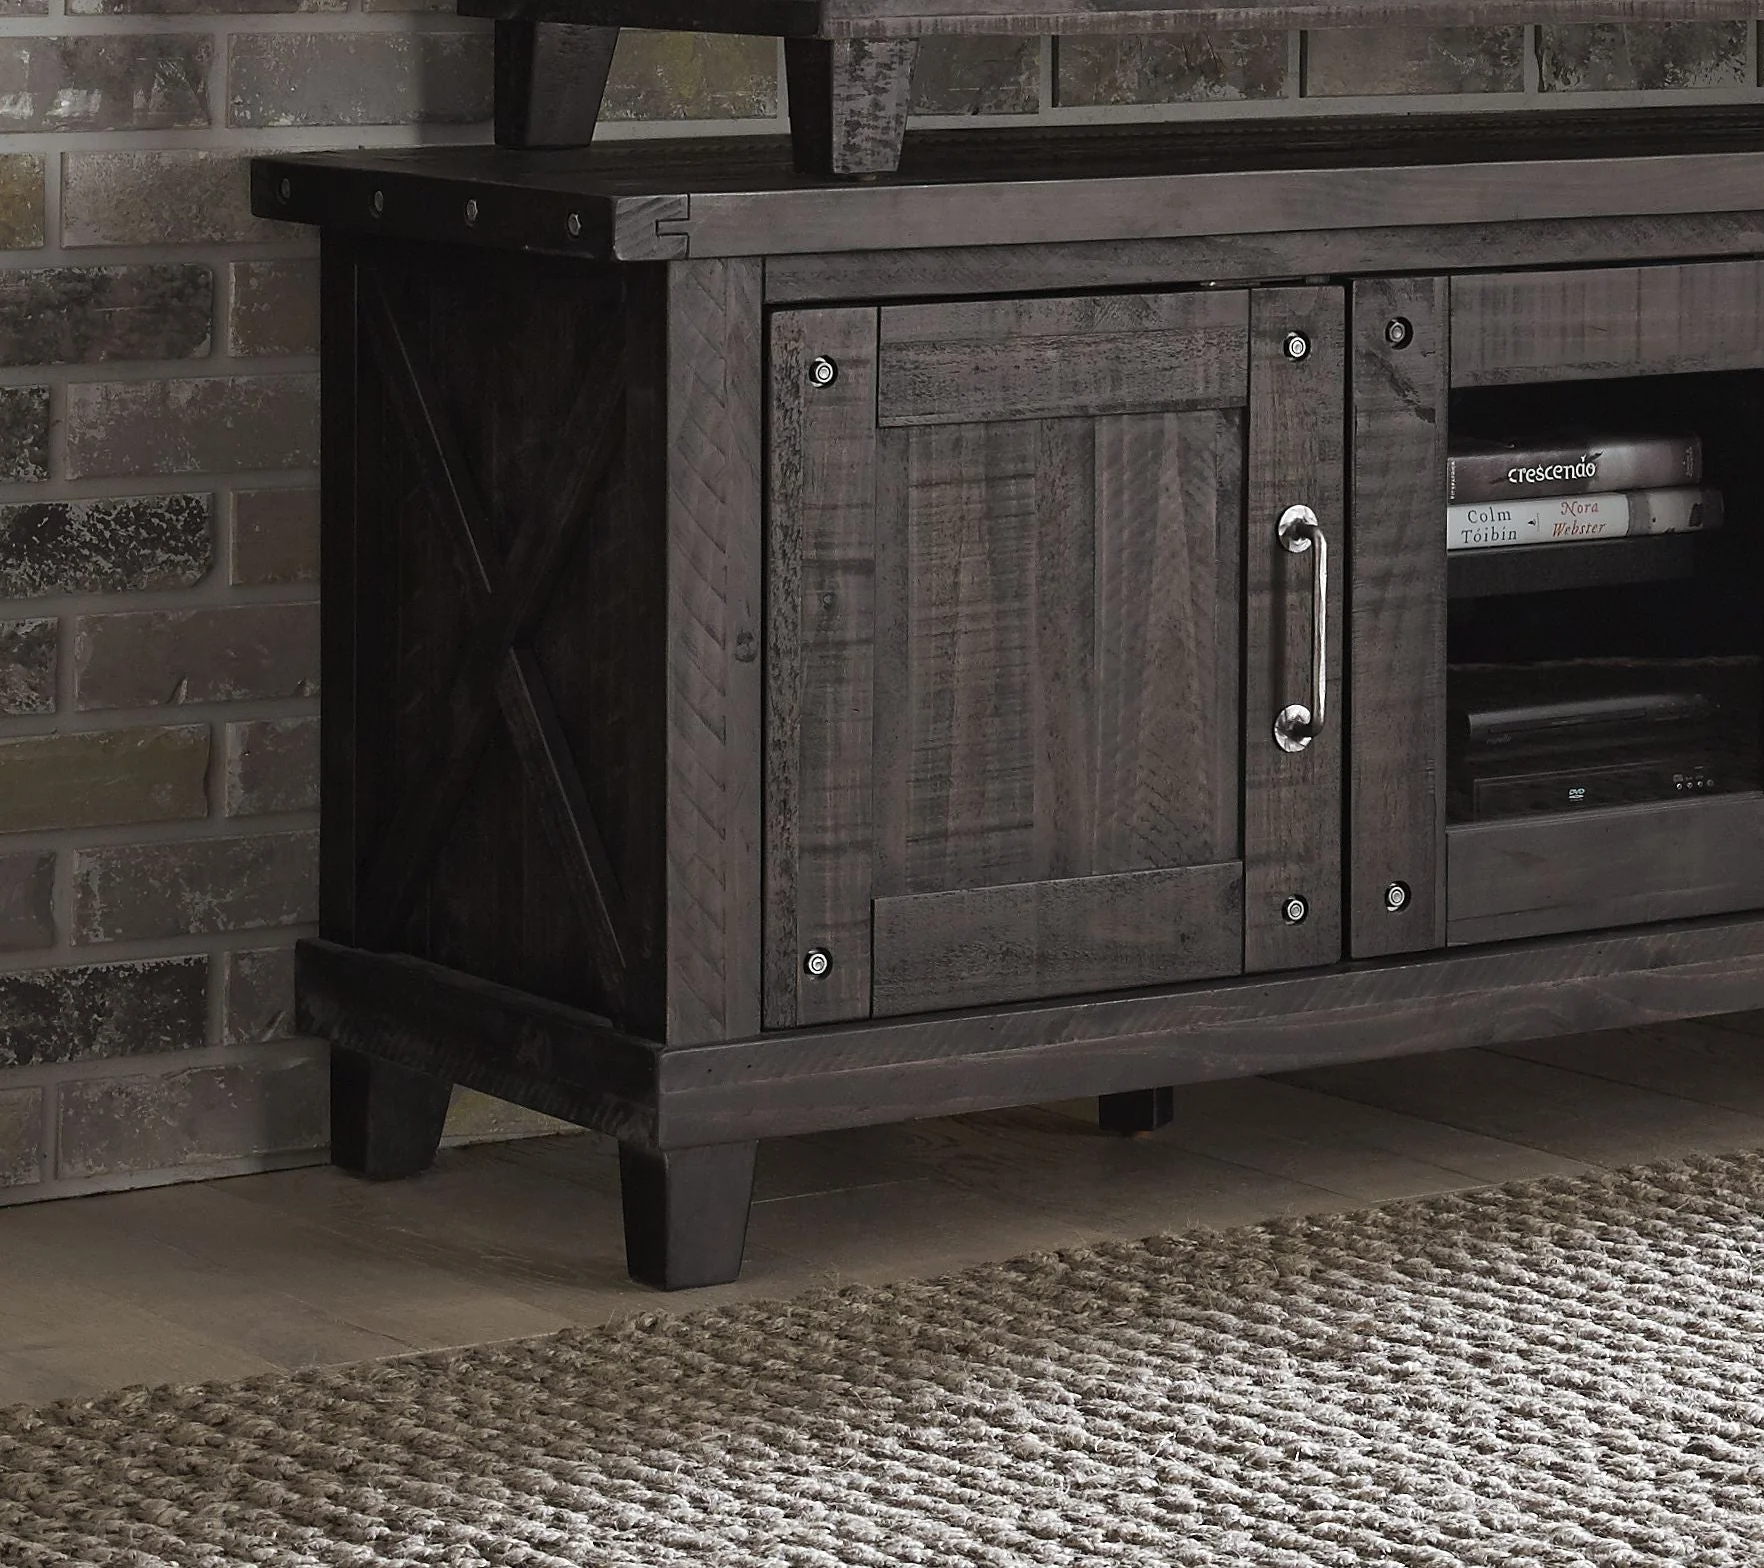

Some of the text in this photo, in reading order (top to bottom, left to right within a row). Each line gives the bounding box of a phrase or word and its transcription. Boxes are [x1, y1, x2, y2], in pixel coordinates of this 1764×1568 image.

[1508, 454, 1596, 484] crescendo
[1467, 507, 1512, 524] Colm
[1561, 501, 1600, 518] Nora
[1461, 526, 1517, 544] Tóibín
[1552, 520, 1607, 538] Webster
